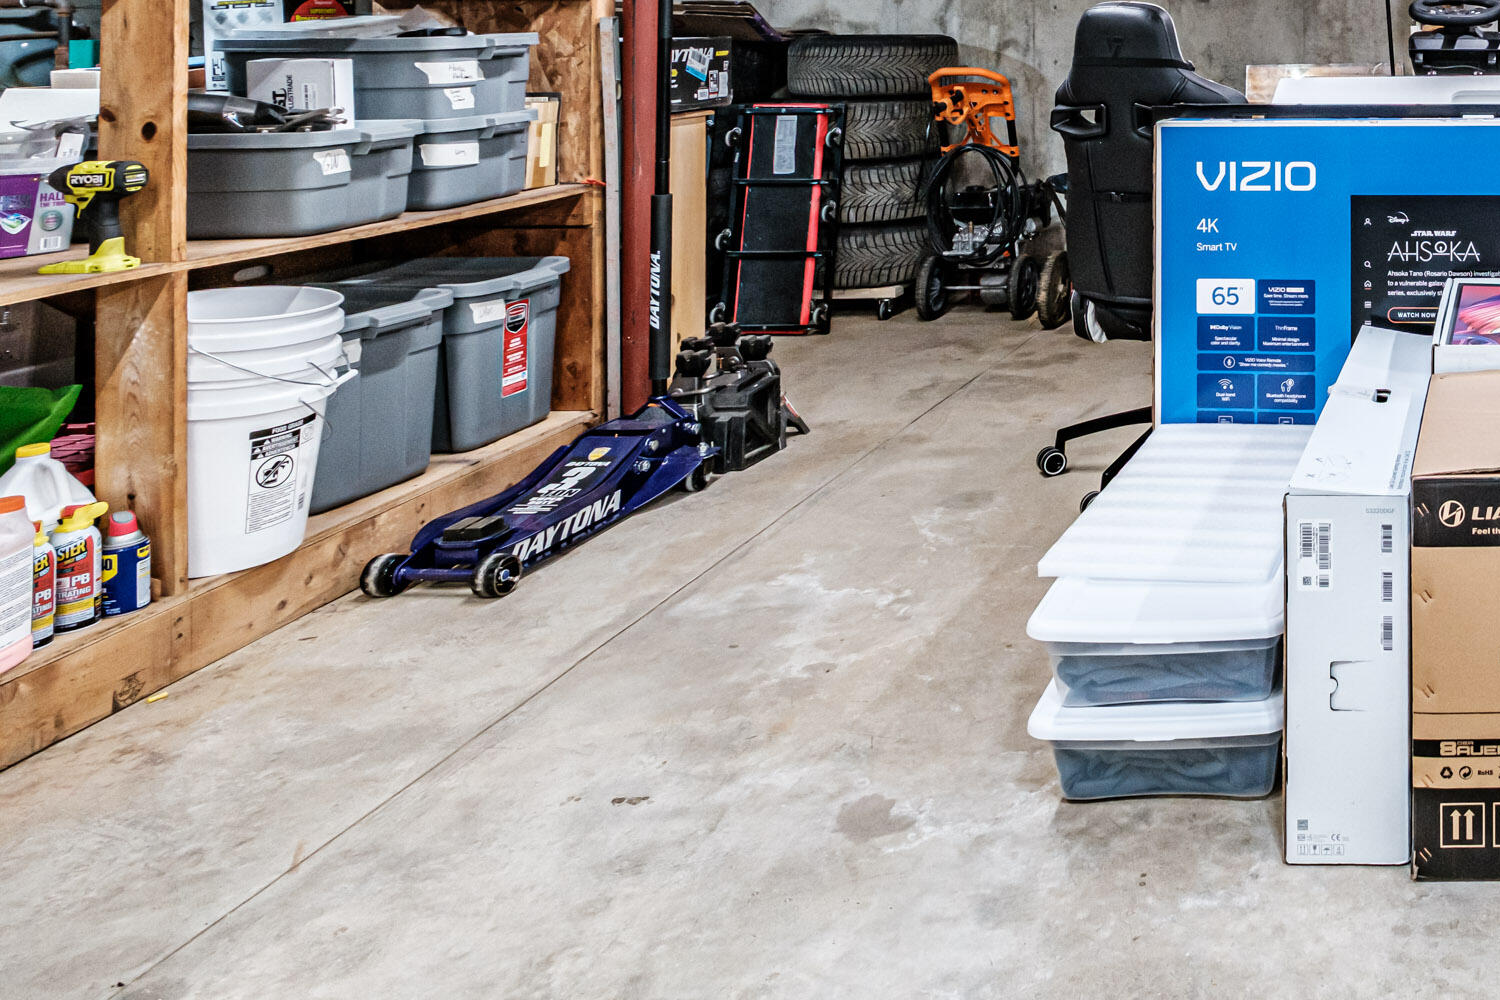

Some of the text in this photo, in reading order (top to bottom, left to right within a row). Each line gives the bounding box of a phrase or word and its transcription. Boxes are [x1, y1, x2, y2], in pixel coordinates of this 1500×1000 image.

[70, 174, 103, 185] RYOBI
[1196, 161, 1316, 191] VIZIO
[1196, 218, 1219, 233] 4K
[1196, 242, 1238, 252] Smart TV
[1387, 241, 1481, 262] AHSOKA
[1387, 270, 1409, 278] Ahsoka
[1409, 270, 1423, 278] Tano
[1424, 270, 1448, 278] (Rosario
[1448, 270, 1473, 278] Dawson)
[1387, 280, 1394, 288] to
[1399, 280, 1427, 288] vulnerable
[512, 489, 622, 562] DAYTONA
[1471, 527, 1491, 535] Feel
